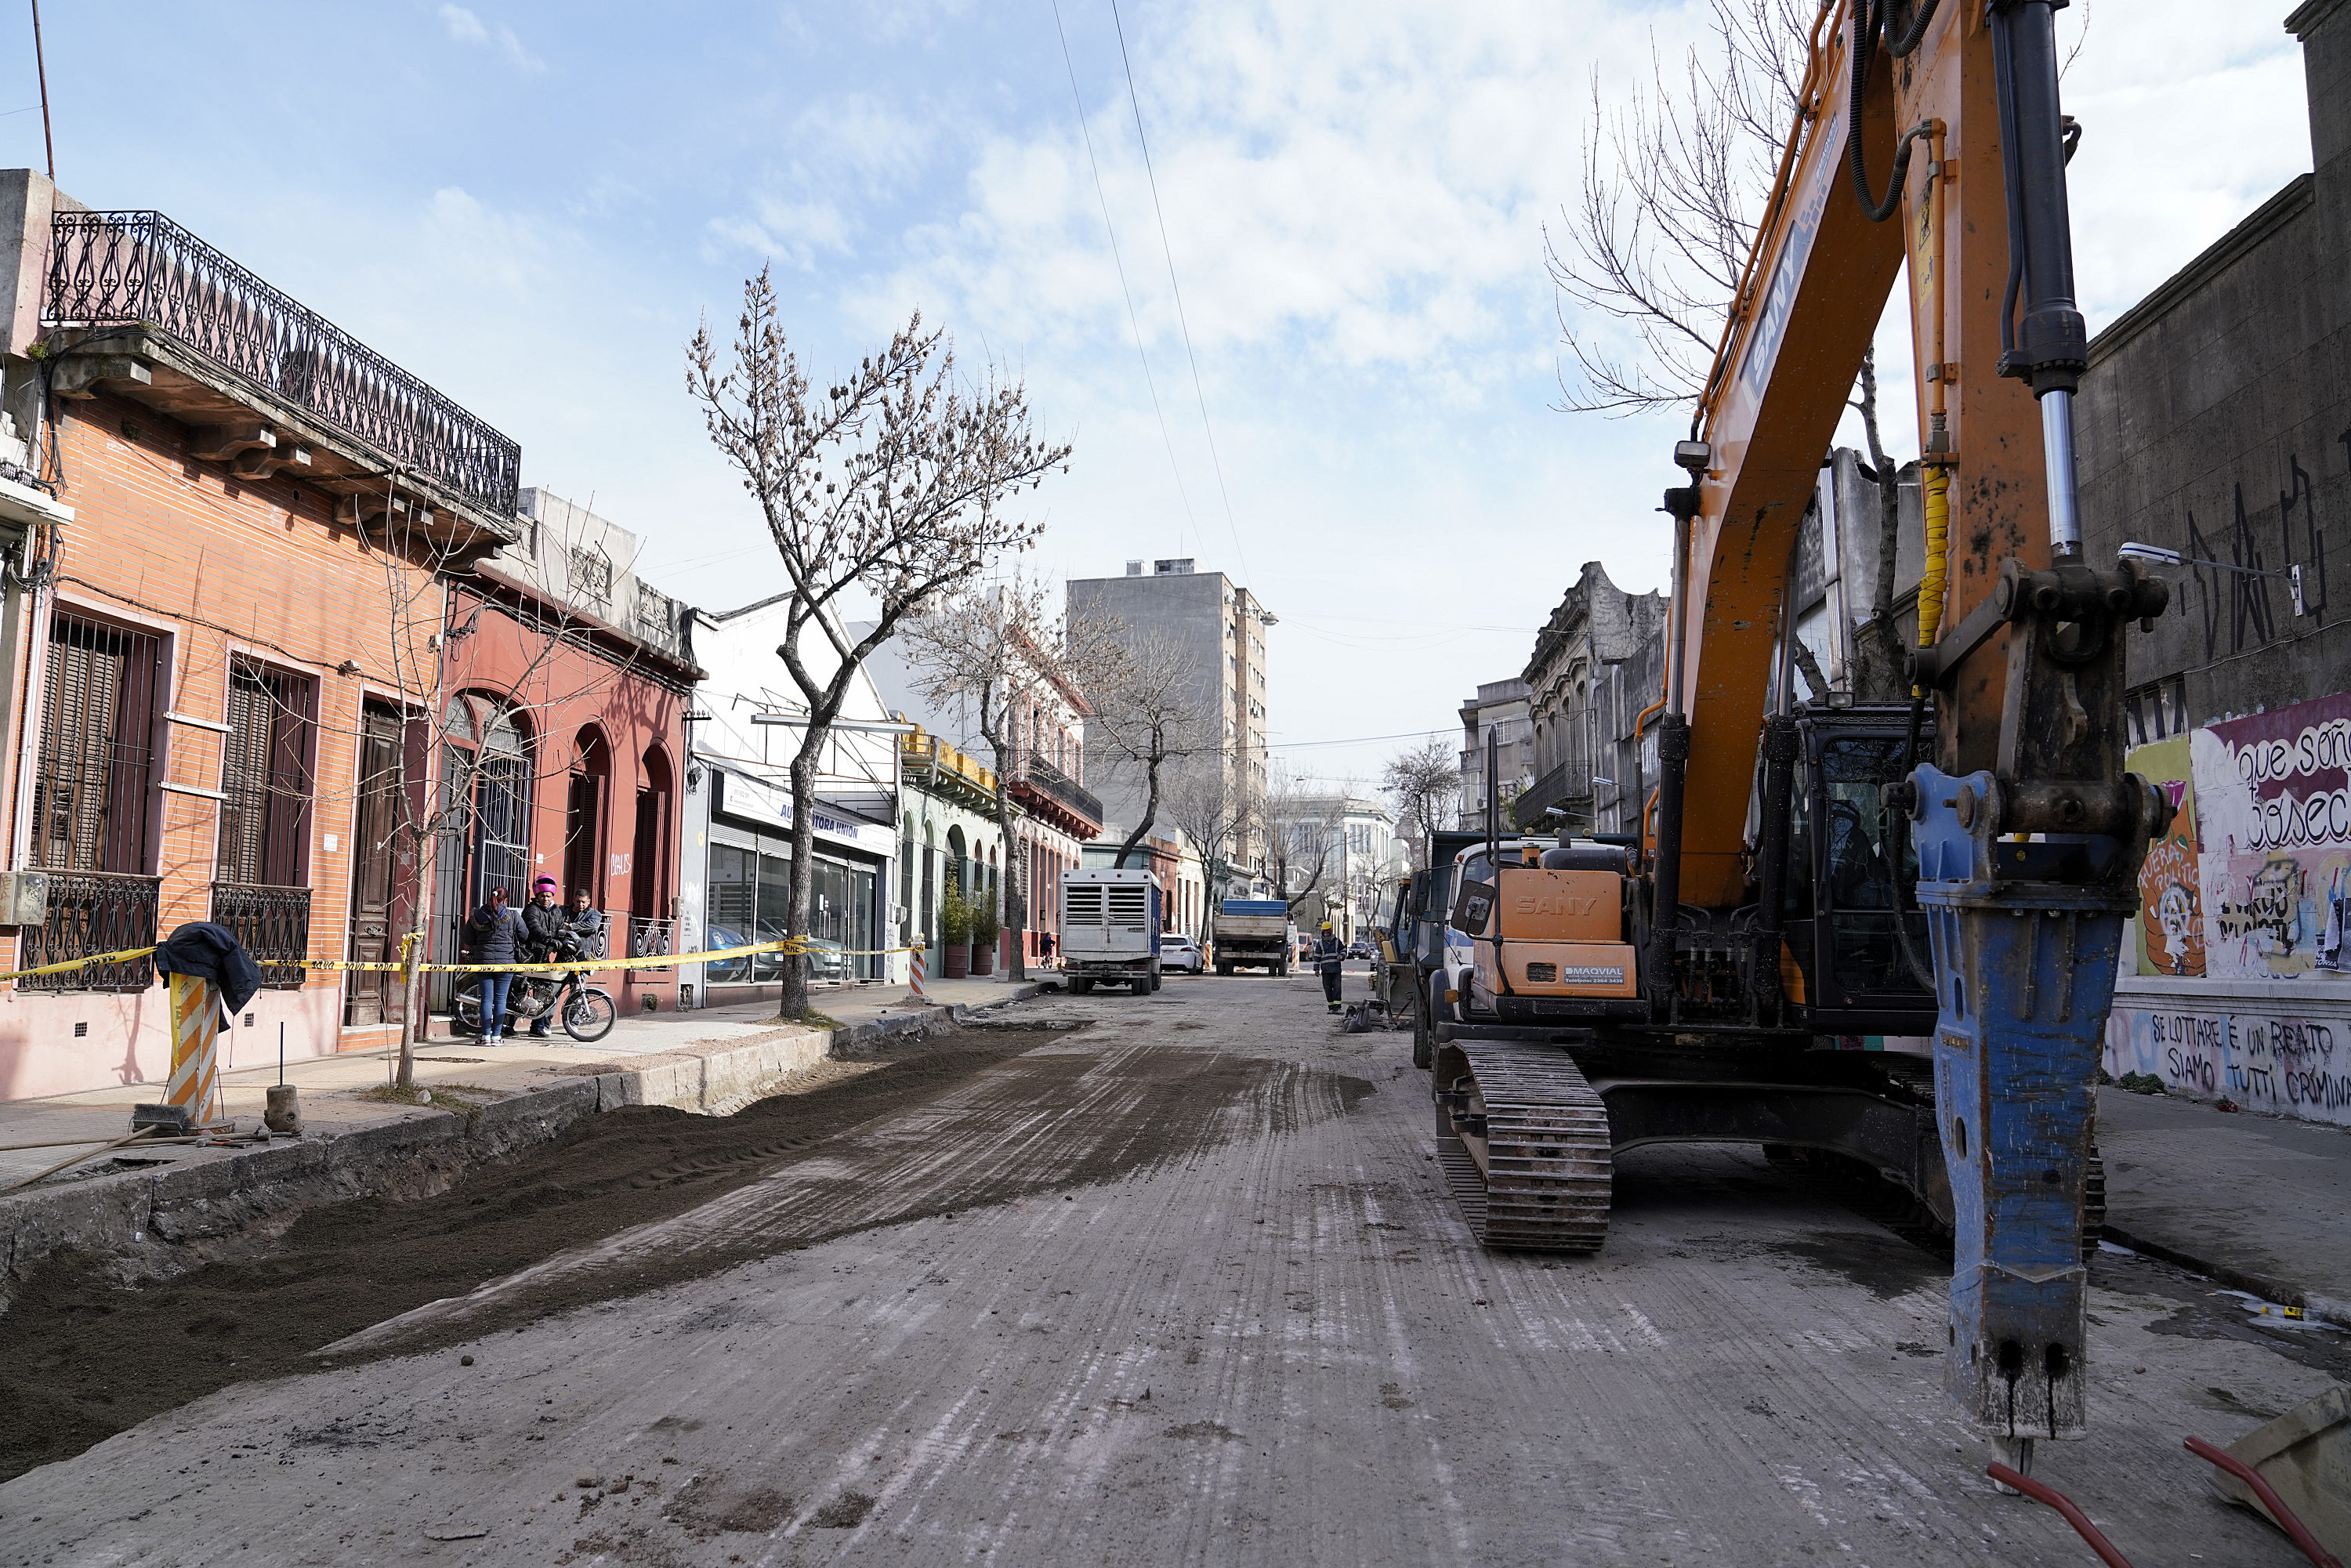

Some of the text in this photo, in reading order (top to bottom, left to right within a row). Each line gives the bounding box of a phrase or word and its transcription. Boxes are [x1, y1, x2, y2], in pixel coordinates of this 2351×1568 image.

[1754, 232, 1795, 385] SANY
[2239, 744, 2286, 801] que
[835, 821, 859, 839] UNION
[1516, 896, 1597, 915] SANY
[2152, 1014, 2166, 1042] SE
[2168, 1016, 2222, 1048] LOTTARE
[2246, 1026, 2265, 1056] UN
[2269, 1020, 2334, 1055] REATO
[2168, 1047, 2215, 1092] SIAMO
